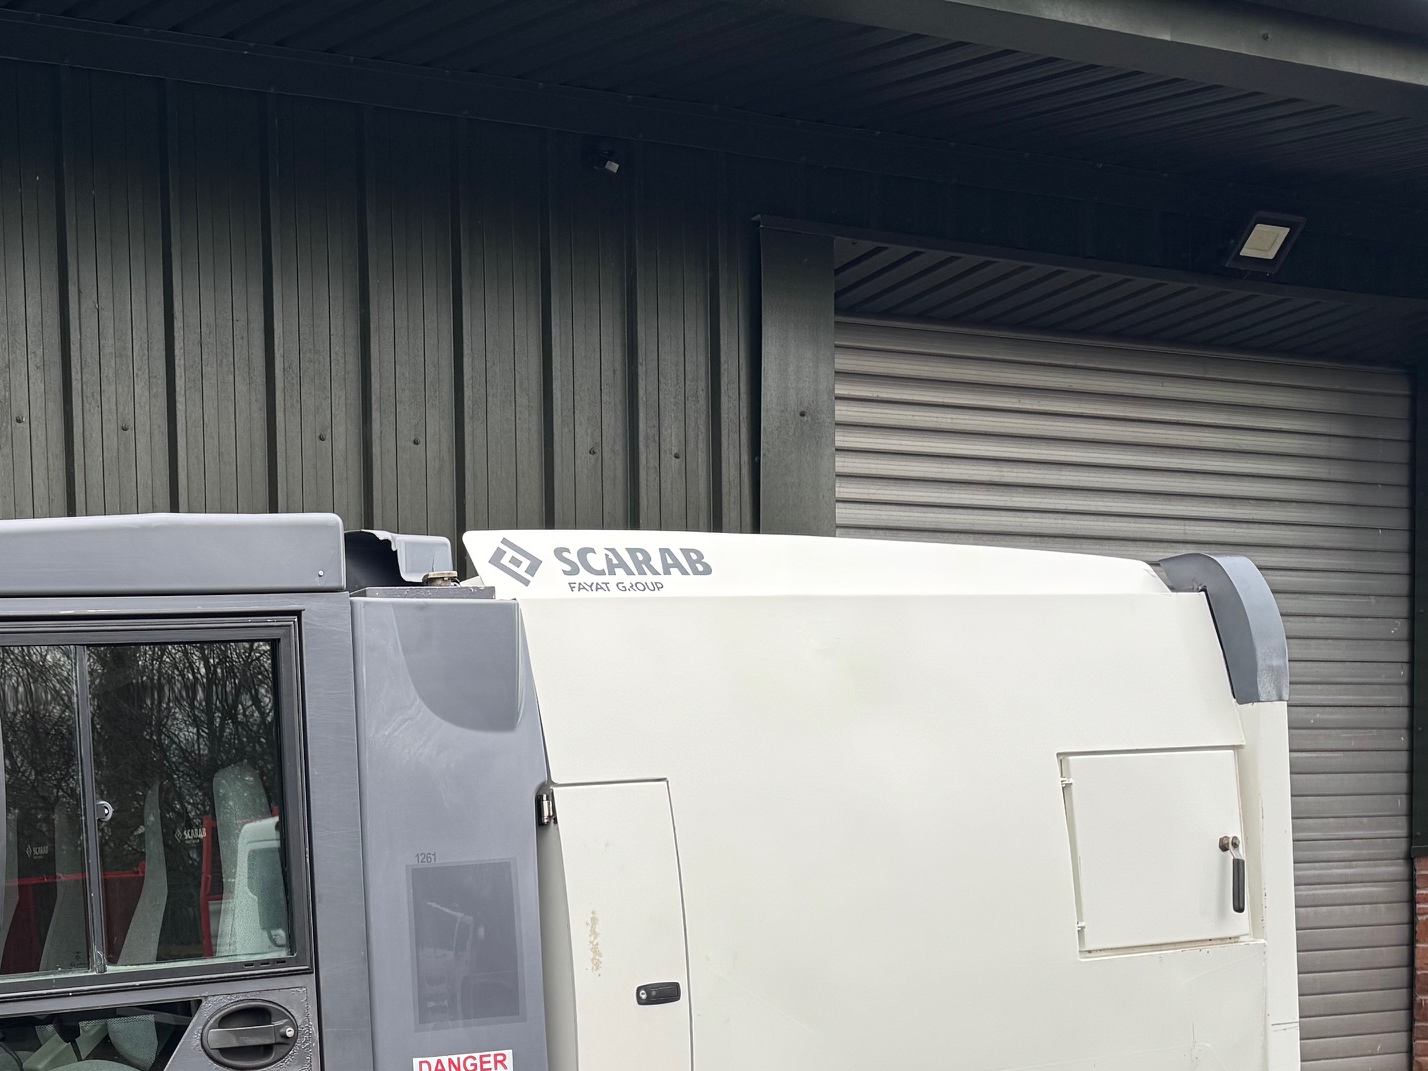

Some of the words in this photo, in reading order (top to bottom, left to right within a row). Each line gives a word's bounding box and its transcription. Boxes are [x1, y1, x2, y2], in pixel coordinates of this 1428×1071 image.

[553, 546, 713, 576] SCARAB
[567, 581, 611, 593] FAYAT
[414, 852, 437, 864] 1261
